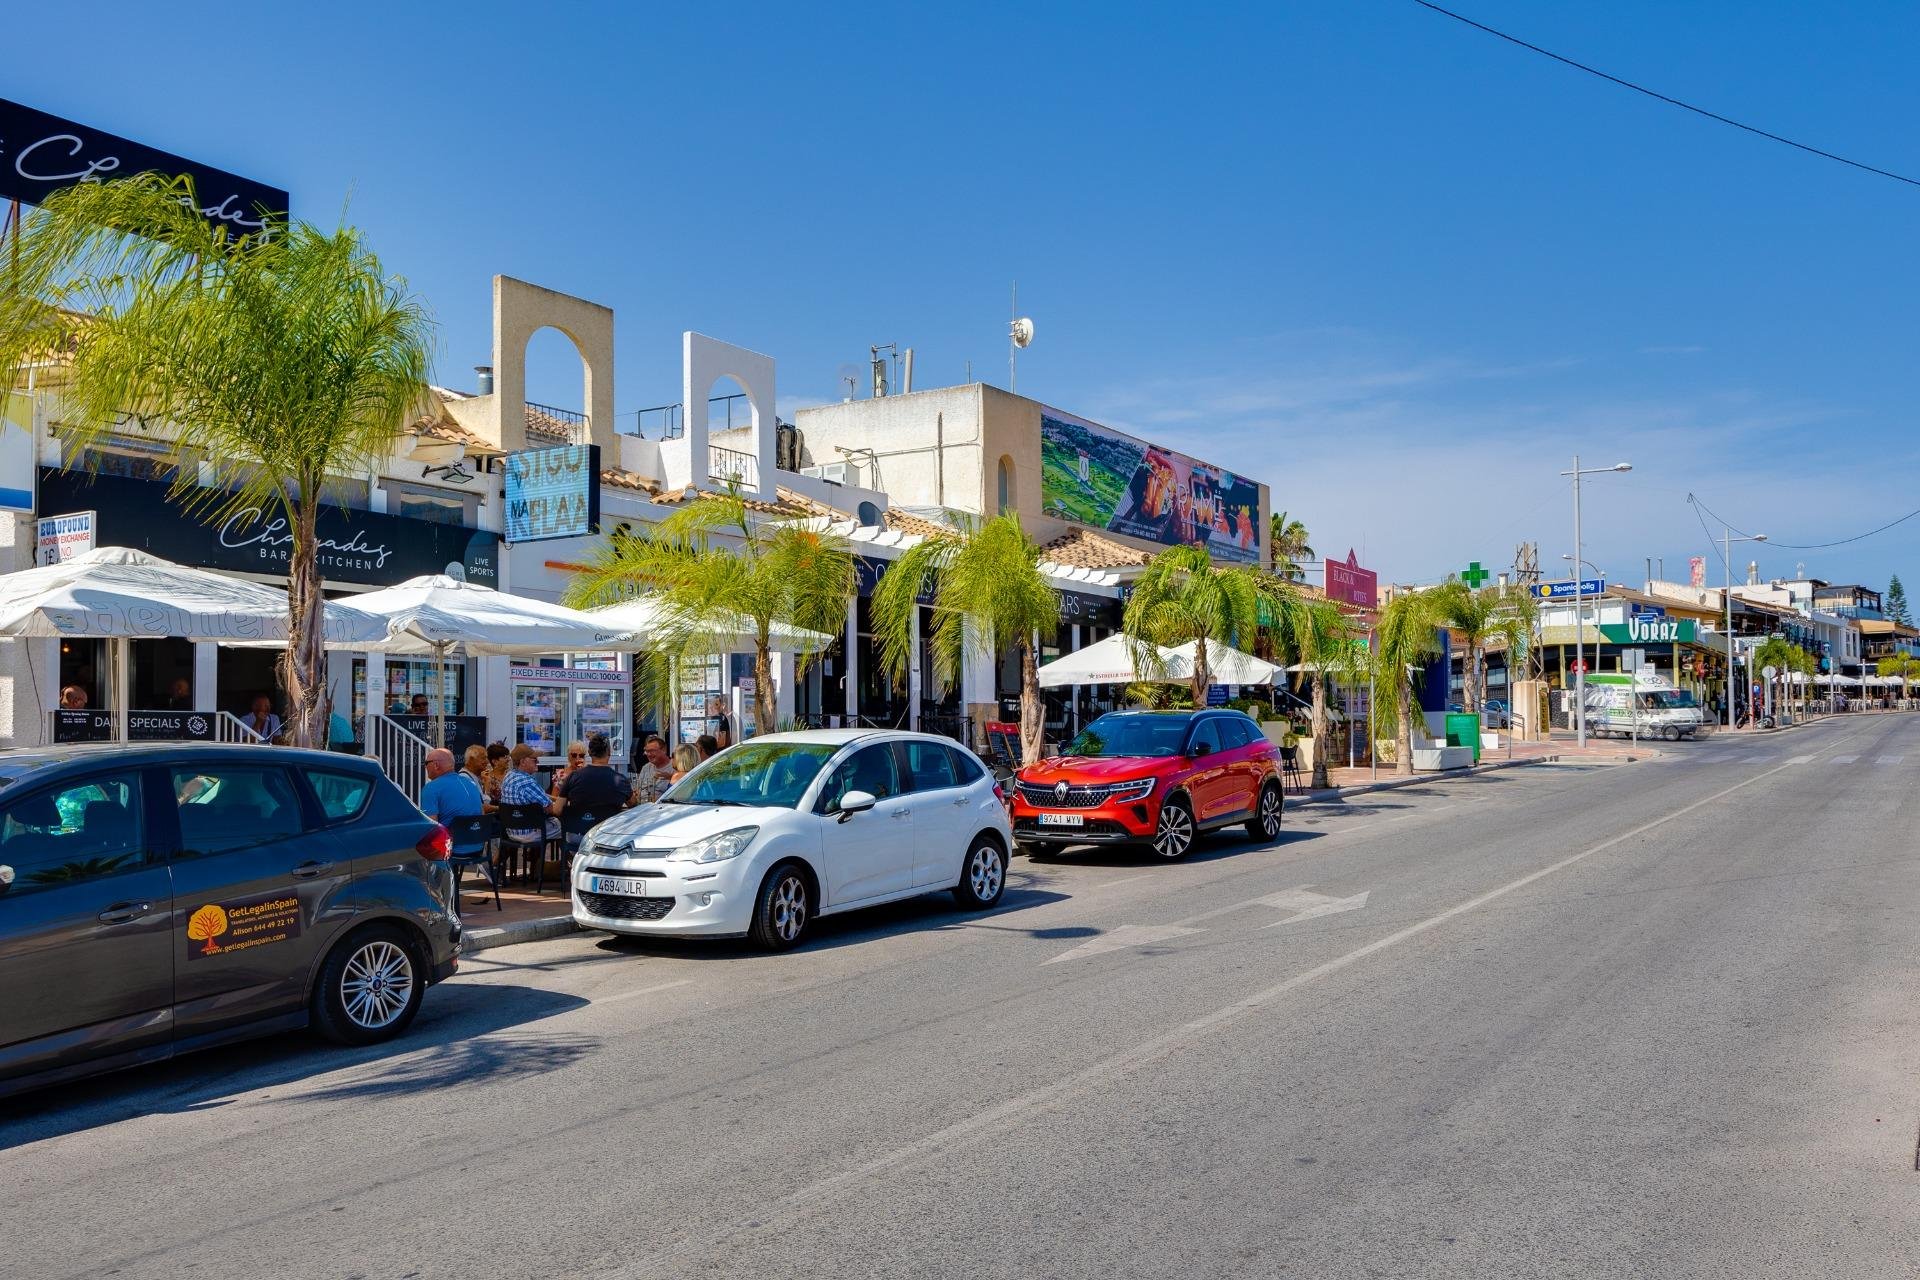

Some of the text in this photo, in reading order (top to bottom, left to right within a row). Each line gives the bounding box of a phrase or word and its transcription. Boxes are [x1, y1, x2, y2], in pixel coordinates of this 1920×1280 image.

[40, 516, 90, 536] EUROPOUND
[40, 532, 90, 546] MONEY EXCHANGE
[260, 548, 287, 560] BAR
[475, 557, 489, 566] LIVE
[469, 566, 494, 577] SPORTS
[511, 668, 622, 681] FIXED FEE FOR SELLING: 1000€
[130, 717, 181, 729] SPECIALS
[408, 721, 457, 730] LIVE SPRTS
[1043, 814, 1062, 823] 9741
[598, 880, 642, 894] 4694 JLR
[228, 898, 298, 918] GetLegalinSpain
[232, 917, 295, 936] Alison 644 49 22 19
[206, 933, 286, 955] www.getlegalinspain.com
